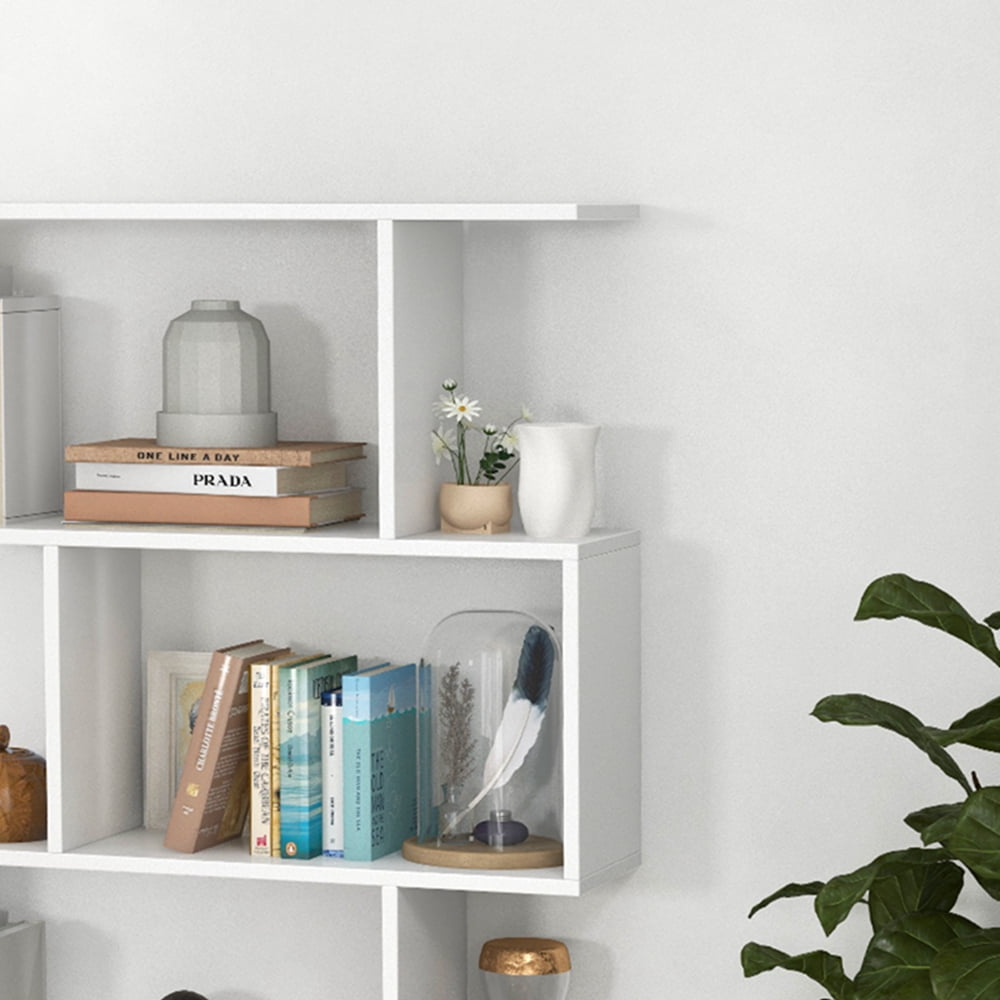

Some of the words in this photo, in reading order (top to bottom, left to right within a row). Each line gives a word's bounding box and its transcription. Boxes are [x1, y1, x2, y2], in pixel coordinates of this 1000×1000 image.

[137, 451, 163, 460] ONE
[168, 452, 198, 461] LINE
[202, 453, 211, 461] A
[214, 453, 240, 462] DAY
[193, 473, 253, 488] PRADA
